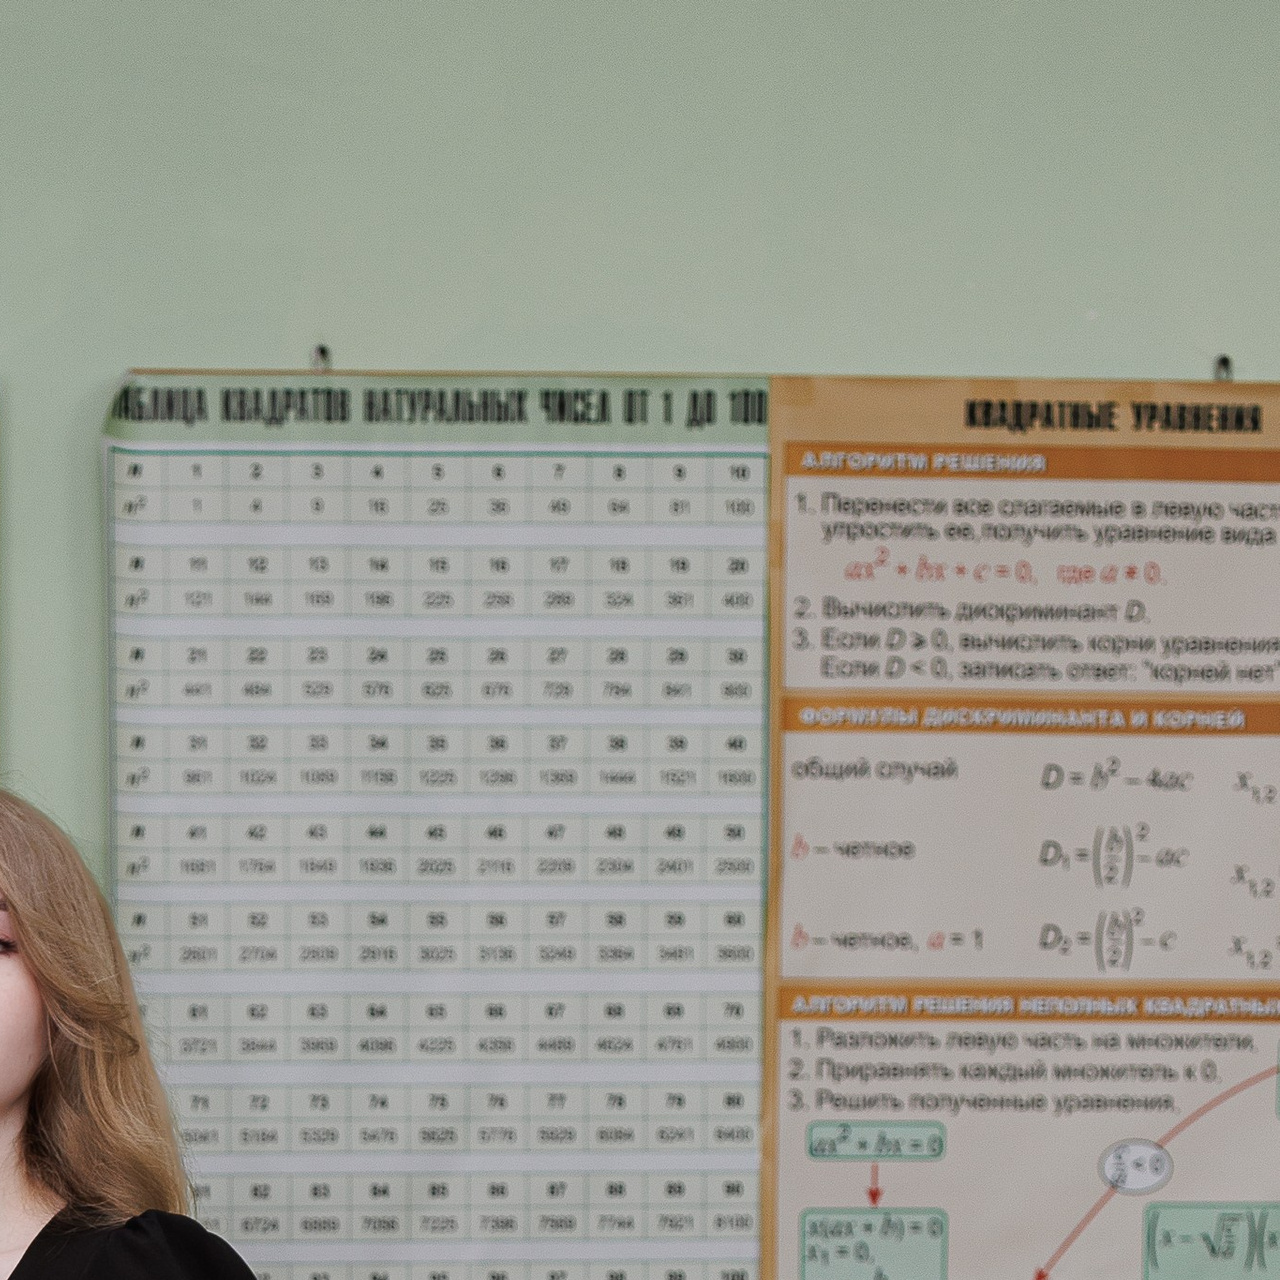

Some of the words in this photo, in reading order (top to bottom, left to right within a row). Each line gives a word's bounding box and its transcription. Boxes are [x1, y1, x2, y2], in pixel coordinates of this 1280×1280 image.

[221, 386, 350, 427] КВАДРАТОВ
[363, 386, 528, 424] НАТУРАЛЬНЫХ
[539, 388, 612, 425] ЧИСЕЛ
[622, 388, 648, 425] ОТ
[685, 387, 716, 428] ДО
[964, 399, 1118, 434] КВАДРАТНЫЕ
[1131, 402, 1263, 433] УРАВНЕНИЯ
